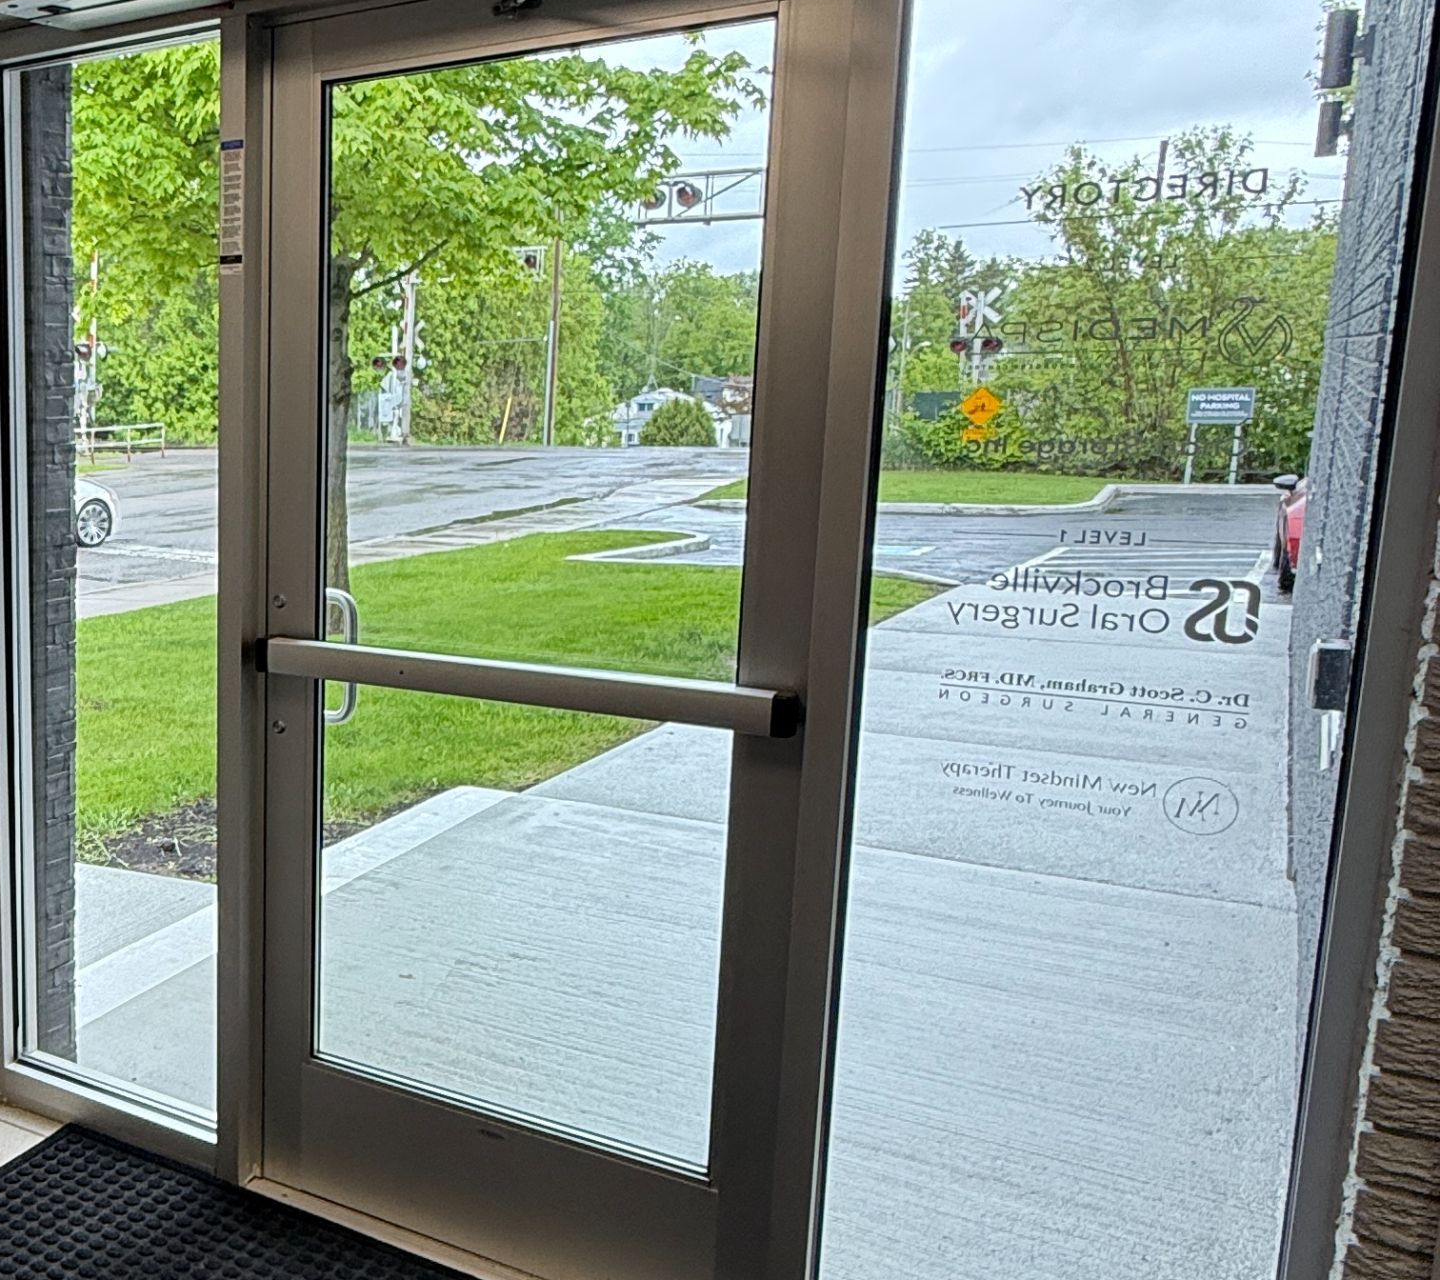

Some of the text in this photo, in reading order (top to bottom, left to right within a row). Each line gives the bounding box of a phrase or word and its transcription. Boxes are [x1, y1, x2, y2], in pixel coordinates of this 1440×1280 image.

[1191, 393, 1251, 402] NO HOSPITAL
[1199, 402, 1240, 410] PARKING
